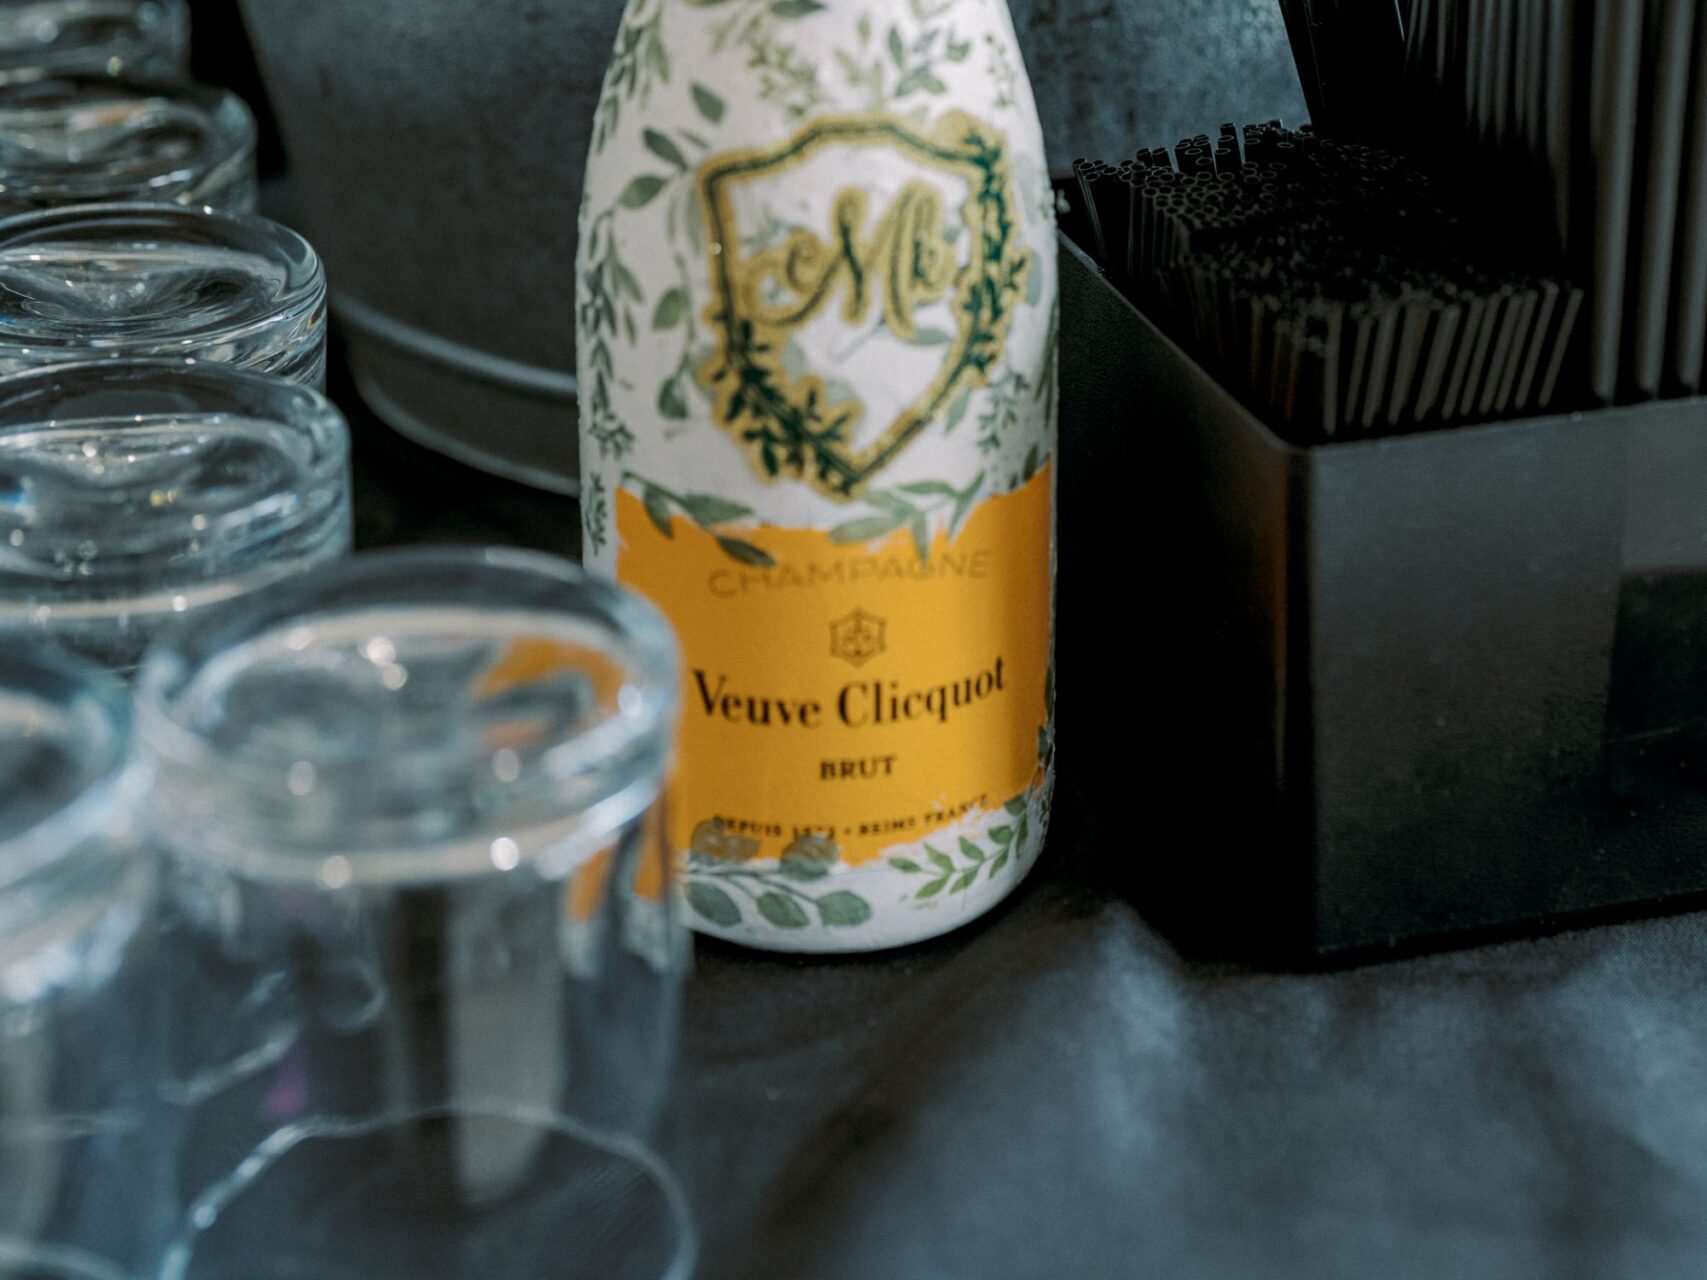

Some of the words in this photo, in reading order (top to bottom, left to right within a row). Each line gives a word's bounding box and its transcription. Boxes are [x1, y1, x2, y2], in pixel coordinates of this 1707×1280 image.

[707, 549, 992, 600] CHAMPAGNE
[693, 669, 821, 730] Veuve
[838, 656, 1005, 730] Clicquot
[819, 755, 898, 781] BRUT
